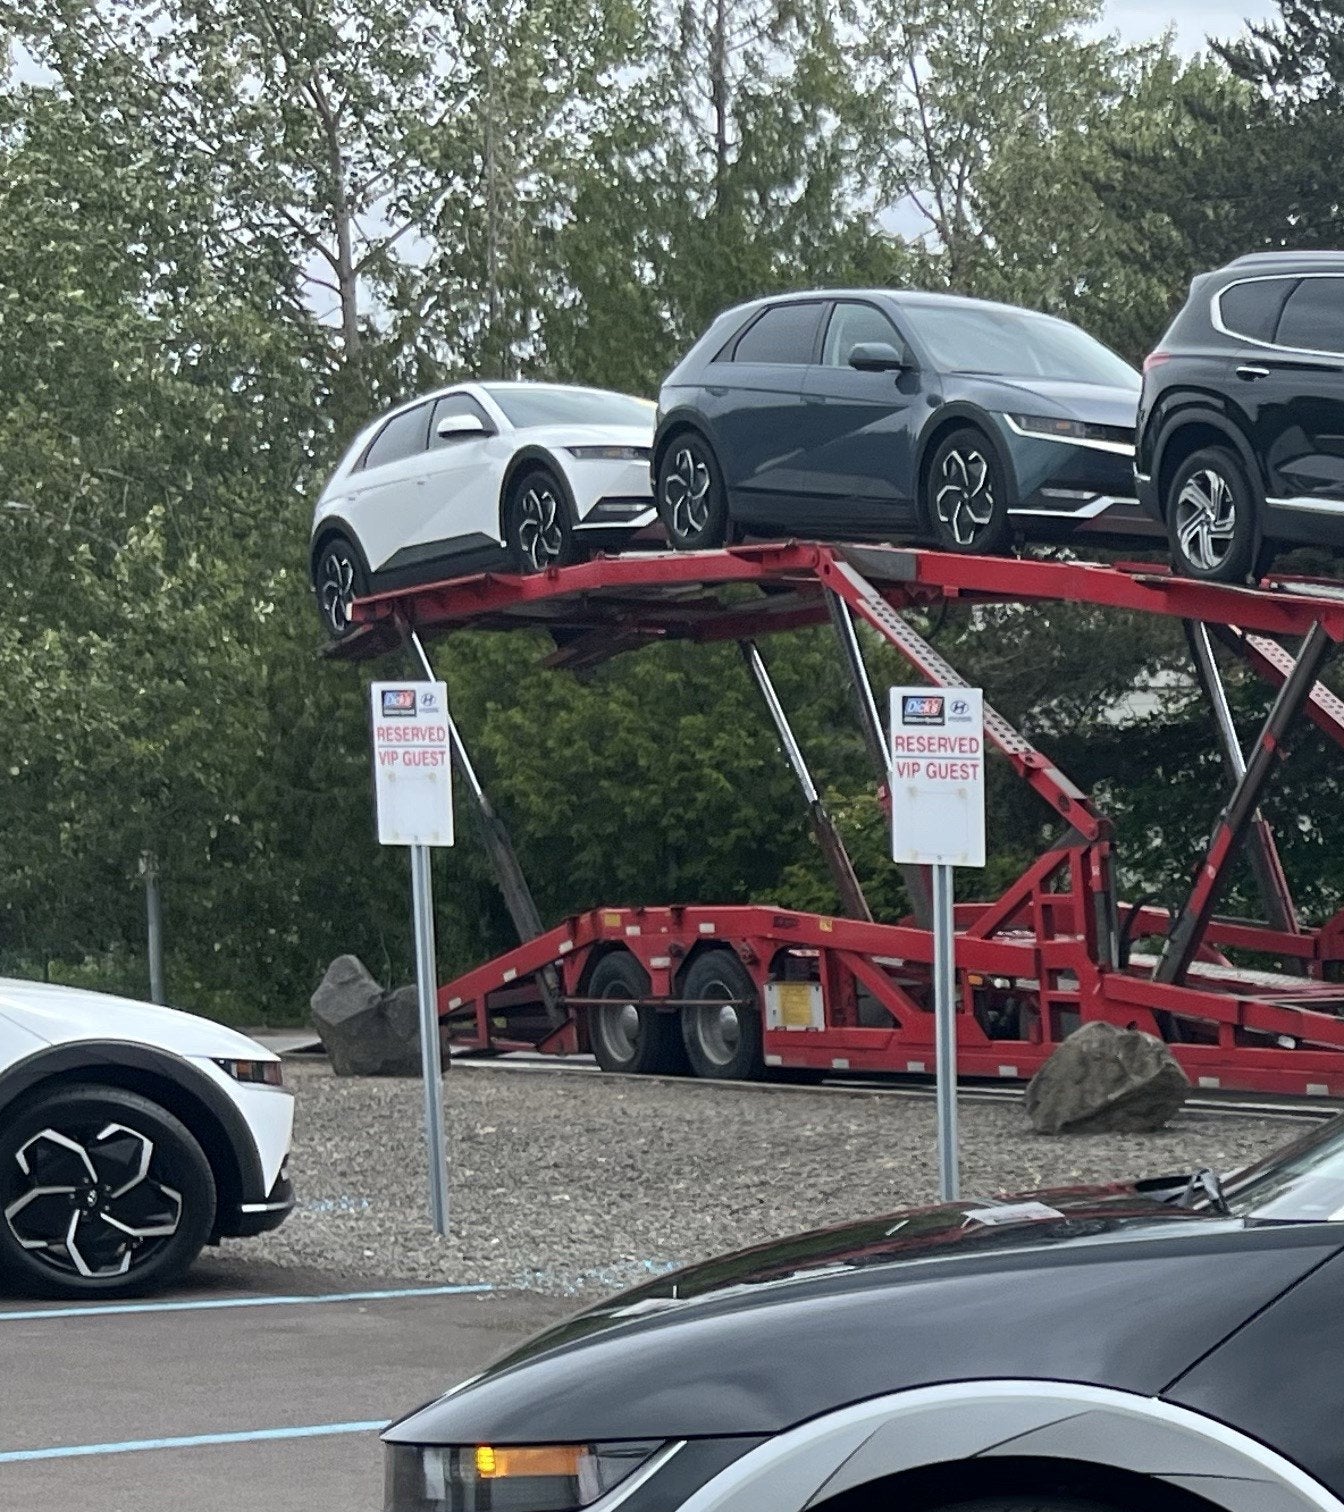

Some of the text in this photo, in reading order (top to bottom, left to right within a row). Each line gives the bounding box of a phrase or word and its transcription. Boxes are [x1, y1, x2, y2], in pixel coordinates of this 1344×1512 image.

[377, 726, 446, 742] RESERVED
[894, 735, 980, 754] RESERVED
[378, 750, 446, 767] VIP GUEST
[896, 762, 980, 781] VIP GUEST
